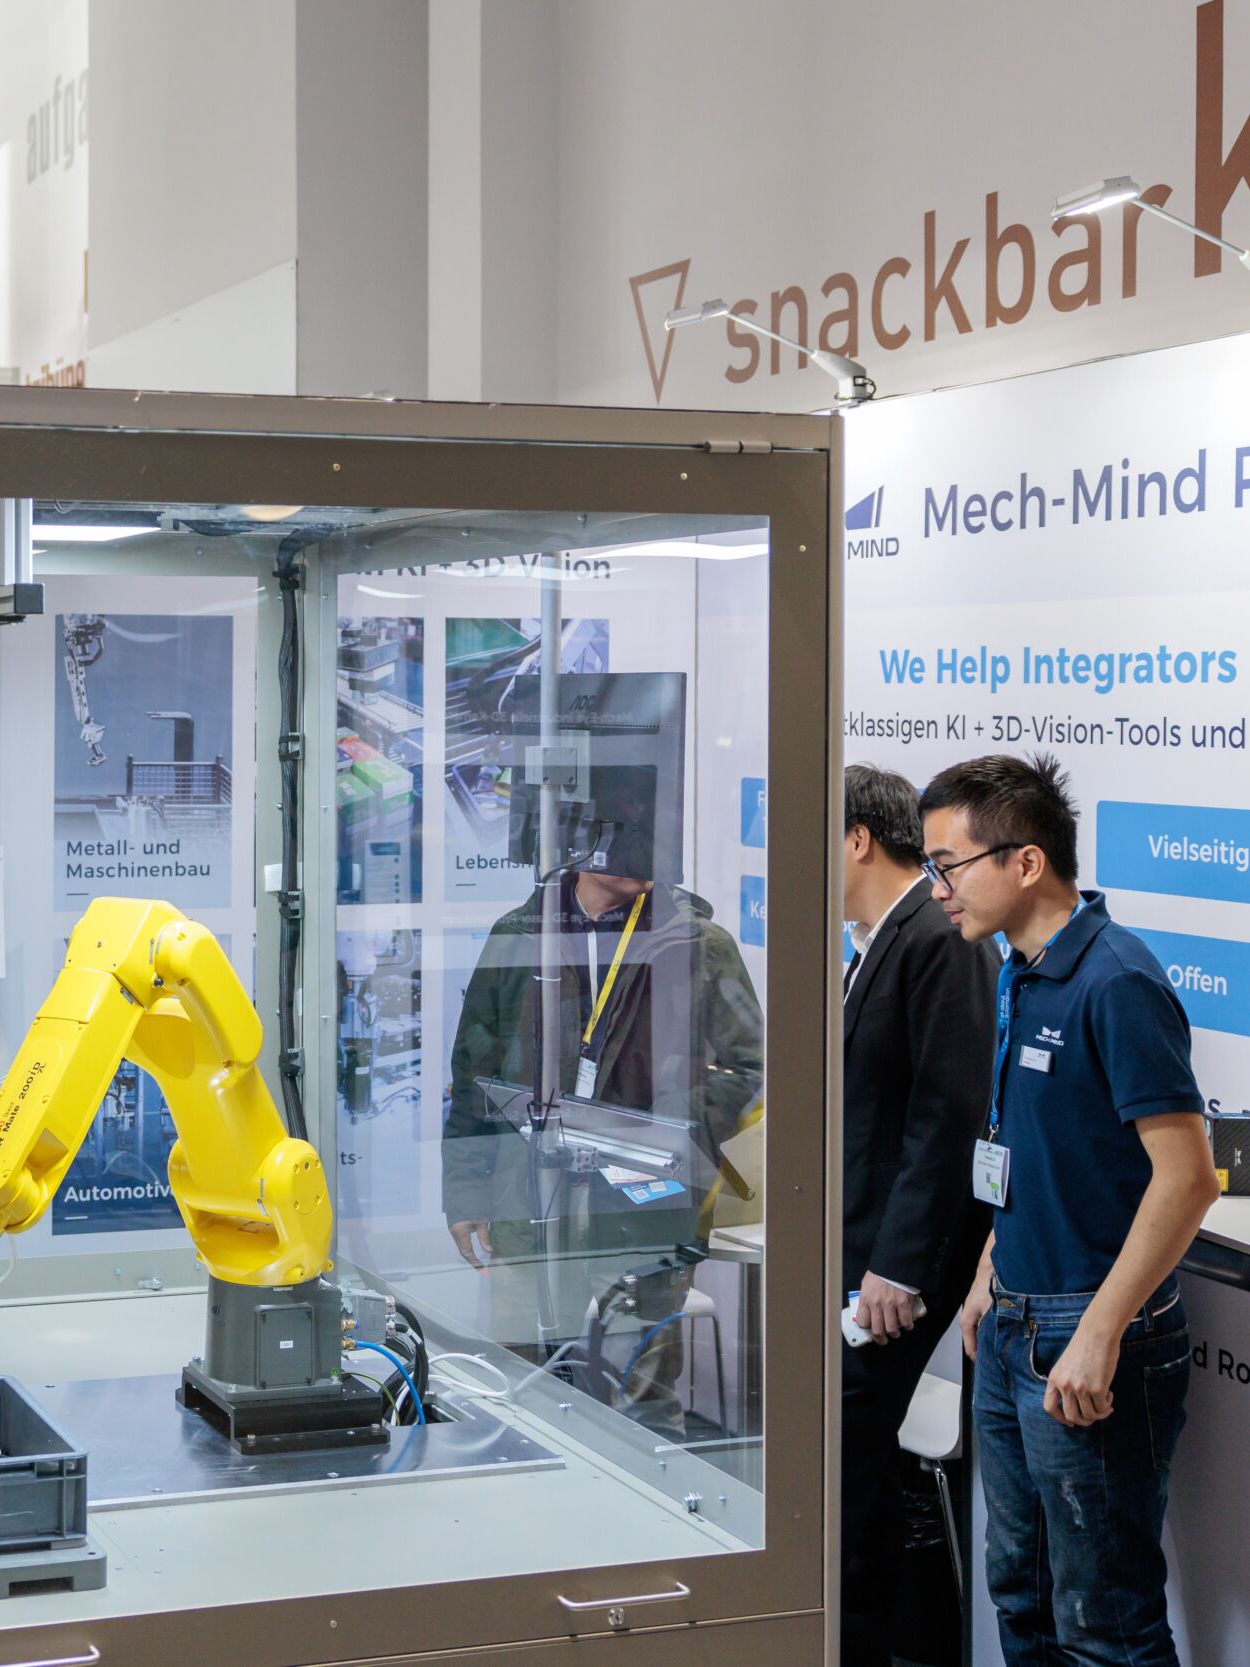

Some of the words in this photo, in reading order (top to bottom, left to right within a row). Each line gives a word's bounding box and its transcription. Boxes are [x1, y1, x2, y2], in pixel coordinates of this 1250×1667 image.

[724, 184, 1174, 385] snackbar
[923, 448, 1207, 539] Mech-Mind
[847, 536, 900, 560] MIND
[879, 648, 926, 685] We
[936, 646, 1011, 694] Help
[1022, 645, 1238, 695] Integrators
[946, 714, 966, 740] KI
[974, 720, 985, 738] +
[991, 715, 1182, 747] 3D-Vision-Tools
[1191, 718, 1247, 749] und
[66, 840, 135, 856] Metall-
[143, 839, 180, 855] und
[1148, 834, 1250, 873] Vielseitig
[66, 861, 211, 879] Maschinenbau
[1167, 964, 1228, 996] Offen
[3, 1105, 20, 1131] Mate
